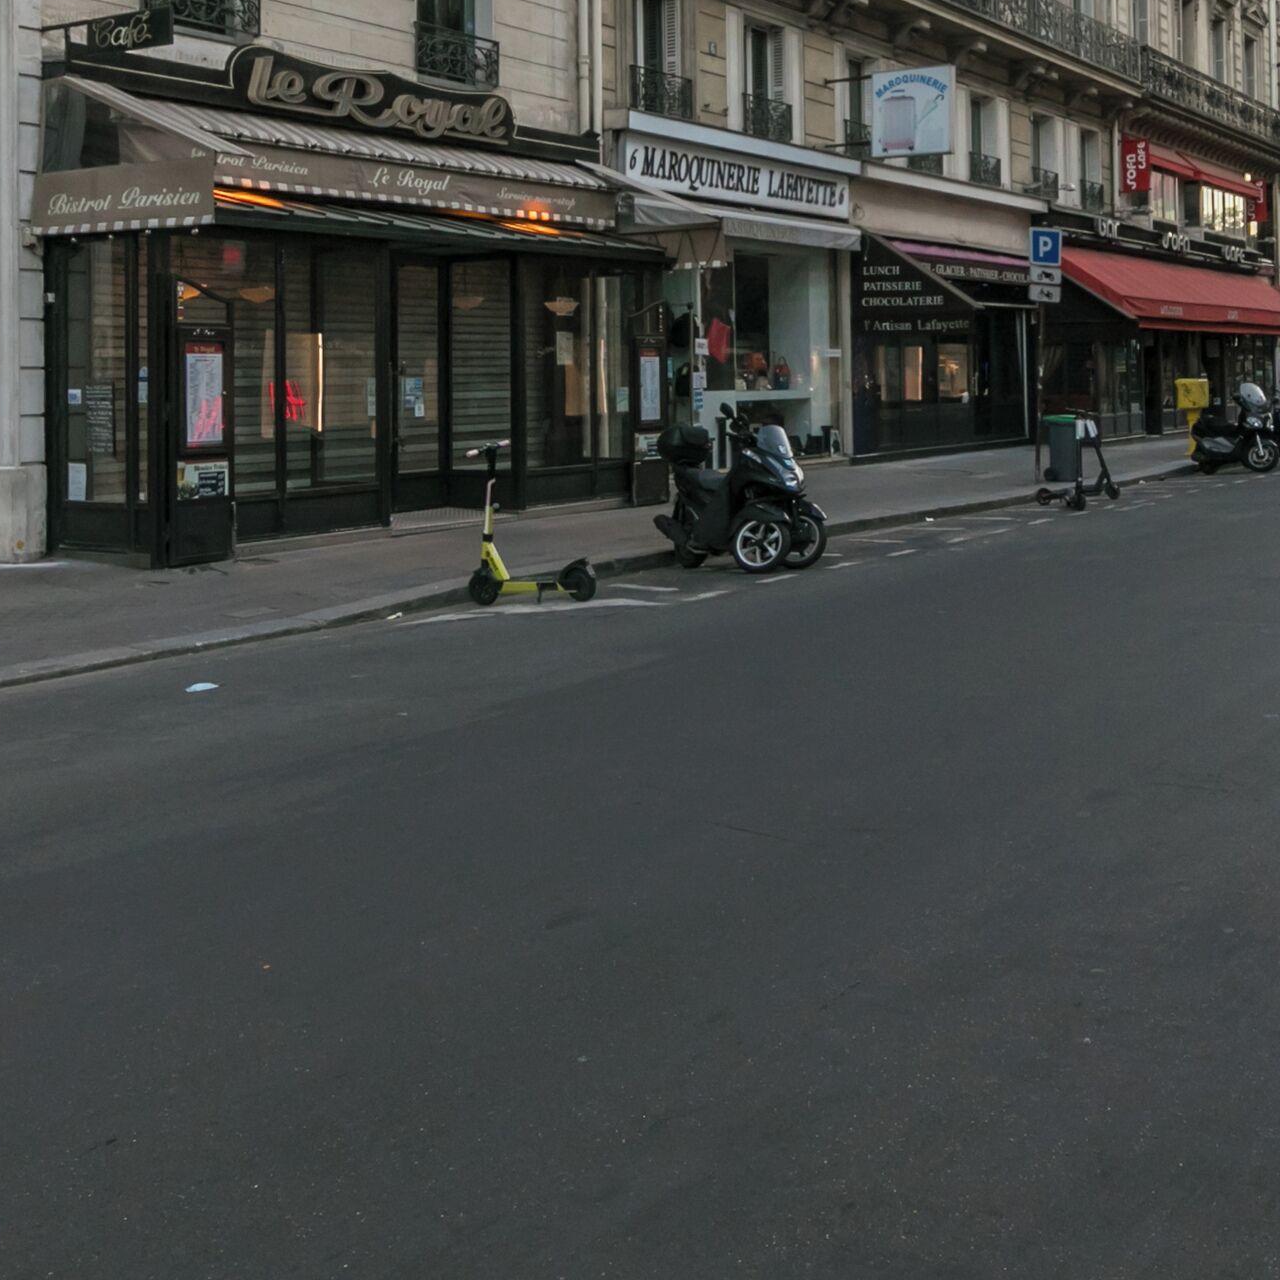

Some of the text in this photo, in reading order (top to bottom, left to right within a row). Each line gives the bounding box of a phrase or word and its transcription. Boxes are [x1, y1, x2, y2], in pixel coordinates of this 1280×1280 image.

[92, 10, 152, 49] Café
[875, 73, 948, 98] MAROQUINERIE
[312, 71, 508, 139] Royal
[250, 155, 309, 176] Parisien
[629, 146, 846, 207] 6 MAROQUINERIE LAFAYETTE 6
[368, 167, 450, 195] Le Royal
[47, 186, 201, 216] Bistrot Parisien
[1038, 236, 1053, 258] P
[863, 266, 900, 276] LUNCH
[863, 281, 922, 291] PATISSERIE
[862, 295, 944, 307] CHOCOLATERIE
[917, 319, 970, 333] Lafayette
